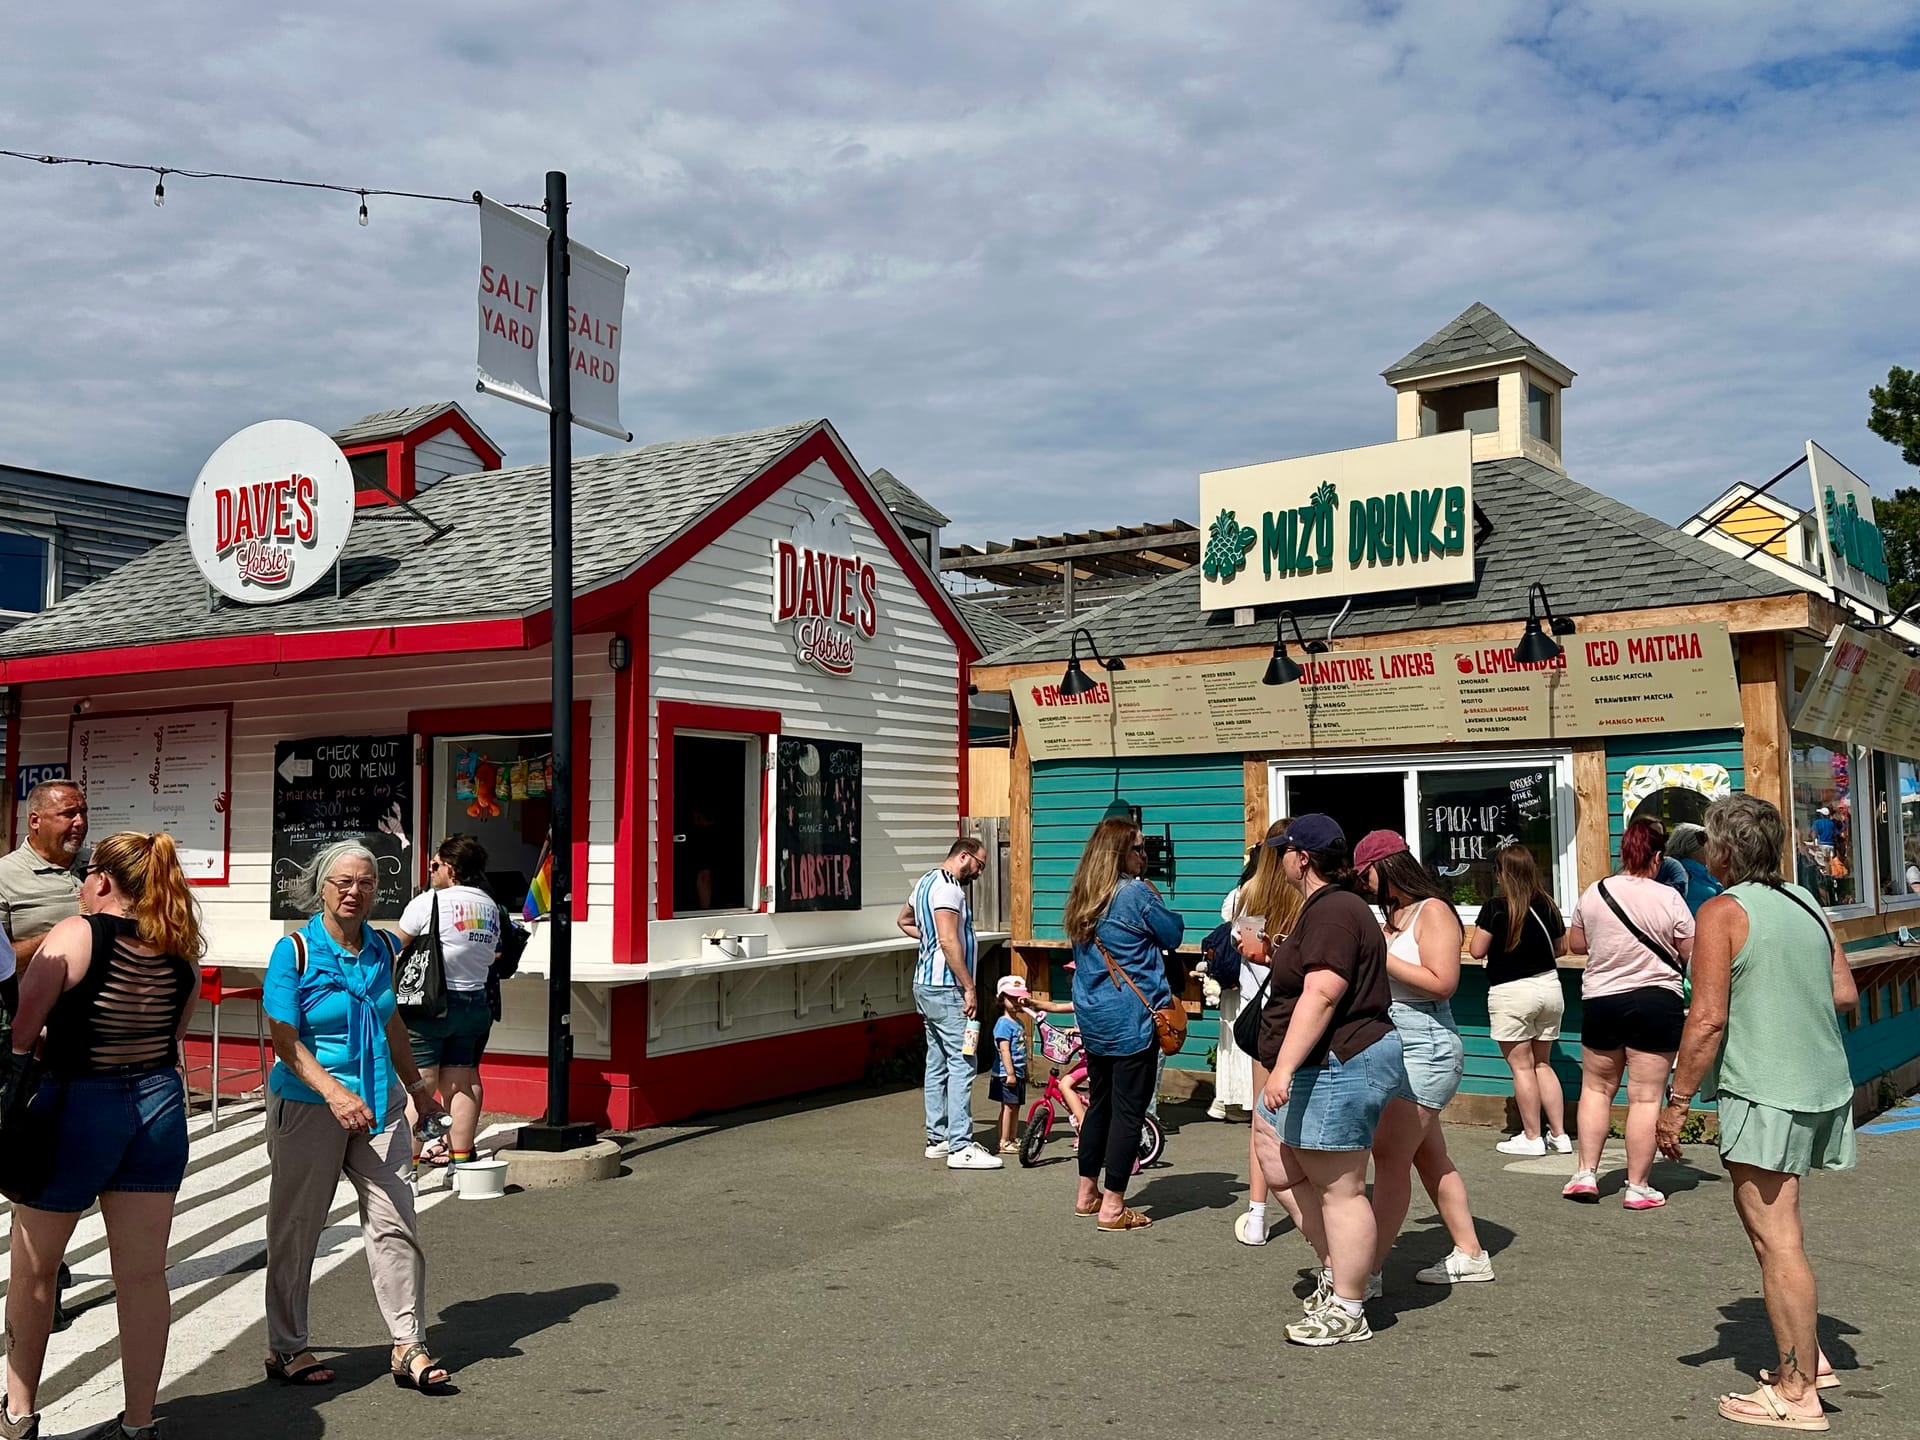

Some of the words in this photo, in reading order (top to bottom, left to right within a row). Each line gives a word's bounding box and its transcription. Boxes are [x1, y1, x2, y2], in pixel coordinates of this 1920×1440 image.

[481, 264, 538, 313] SALT
[482, 304, 534, 350] YARD
[568, 305, 618, 349] SALT
[215, 474, 314, 553] DAVE'S
[1262, 495, 1335, 576] MIZO
[1350, 486, 1465, 564] DRINKS
[237, 541, 289, 580] Lobster
[778, 542, 876, 637] DAVE'S
[801, 618, 855, 663] Lobster
[1585, 640, 1619, 667] ICED
[1627, 633, 1702, 664] MATCHA
[1298, 657, 1375, 684] SIGNATURE
[1380, 652, 1435, 679] LAYERS
[1590, 674, 1621, 682] CLASSIC
[1623, 672, 1653, 680] MATCHA
[1594, 696, 1641, 704] STRAWBERRY
[1643, 693, 1674, 701] MATCHA
[317, 744, 359, 761] CHECK
[371, 742, 399, 759] OUT
[149, 756, 161, 794] other
[329, 764, 351, 779] OUR
[360, 762, 396, 779] MENU
[1509, 775, 1535, 791] ORDER
[286, 787, 324, 800] market
[1511, 789, 1534, 802] OTHER
[1435, 805, 1500, 833] PICK-UP
[1450, 835, 1488, 860] HERE
[790, 854, 853, 900] LOBSTER
[468, 931, 493, 944] RODEO
